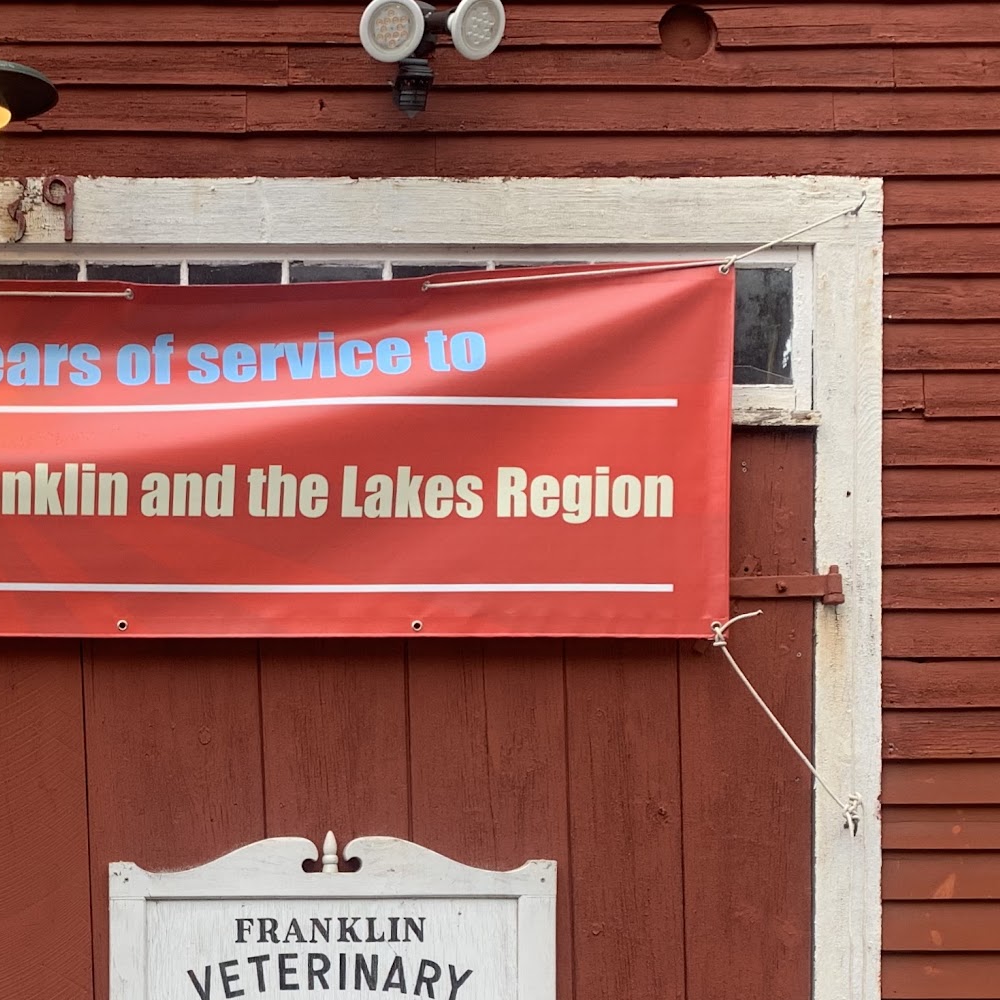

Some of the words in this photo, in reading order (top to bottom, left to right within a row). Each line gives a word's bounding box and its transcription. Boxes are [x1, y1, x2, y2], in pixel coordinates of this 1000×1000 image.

[115, 333, 176, 387] of
[186, 330, 413, 386] service
[427, 328, 487, 374] to
[139, 464, 236, 519] and
[246, 463, 330, 519] the
[340, 465, 484, 520] Lakes
[496, 466, 675, 524] Region
[234, 916, 426, 943] FRANKLIN
